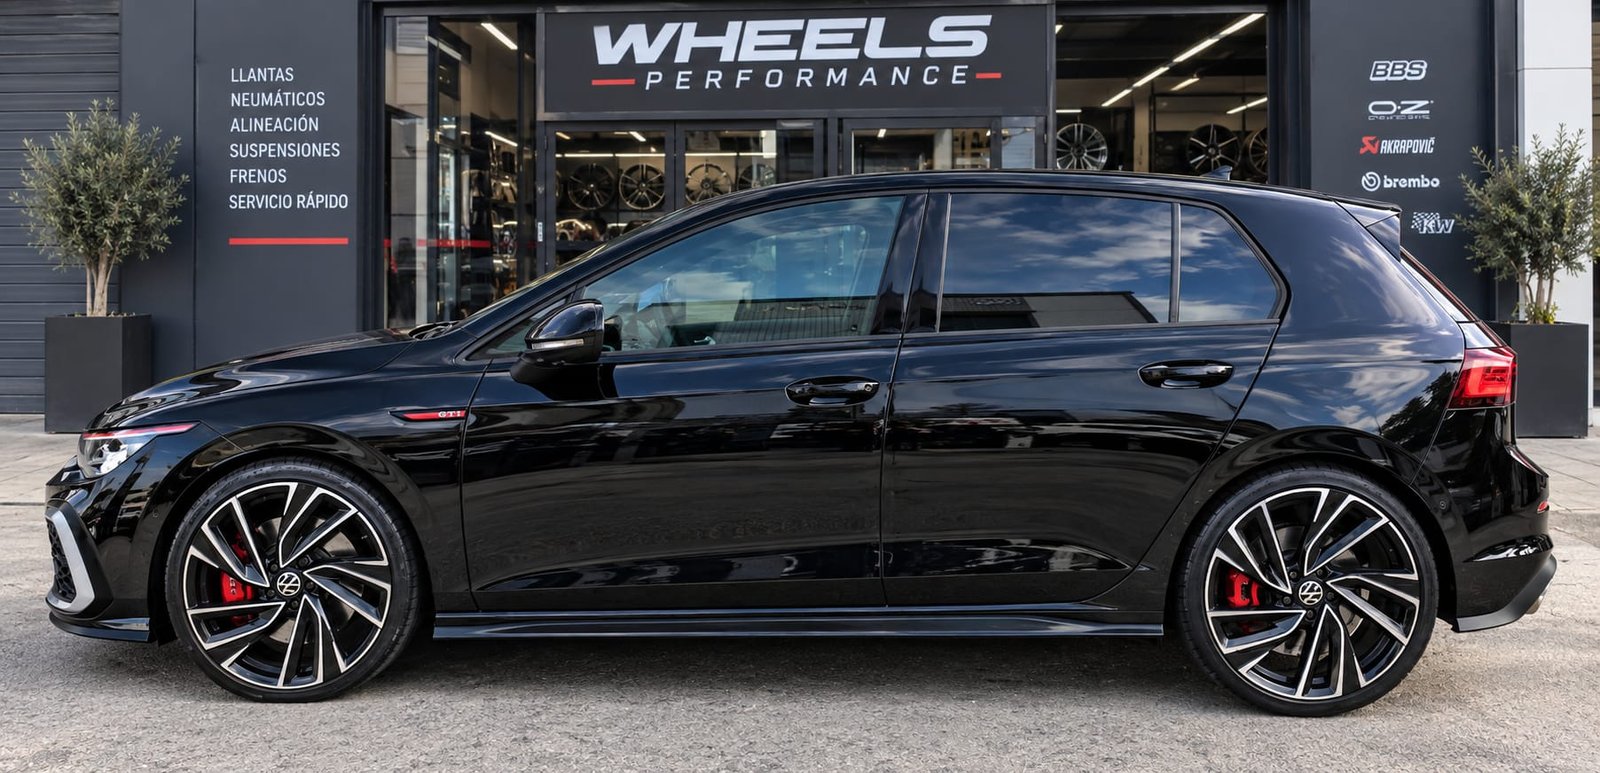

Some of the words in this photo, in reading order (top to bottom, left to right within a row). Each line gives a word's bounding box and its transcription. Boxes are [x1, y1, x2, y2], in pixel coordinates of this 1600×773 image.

[593, 15, 992, 65] WHEELS
[231, 67, 294, 82] LLANTAS
[645, 65, 969, 91] PERFORMANCE
[1369, 60, 1428, 82] BBS
[231, 89, 326, 107] NEUMÁTICOS
[230, 114, 319, 132] ALINEACIÓN
[229, 143, 341, 158] SUSPENSIONES
[230, 168, 287, 183] FRENOS
[1383, 174, 1441, 188] brembo
[229, 194, 292, 209] SERVICIO
[297, 191, 349, 209] RÁPIDO
